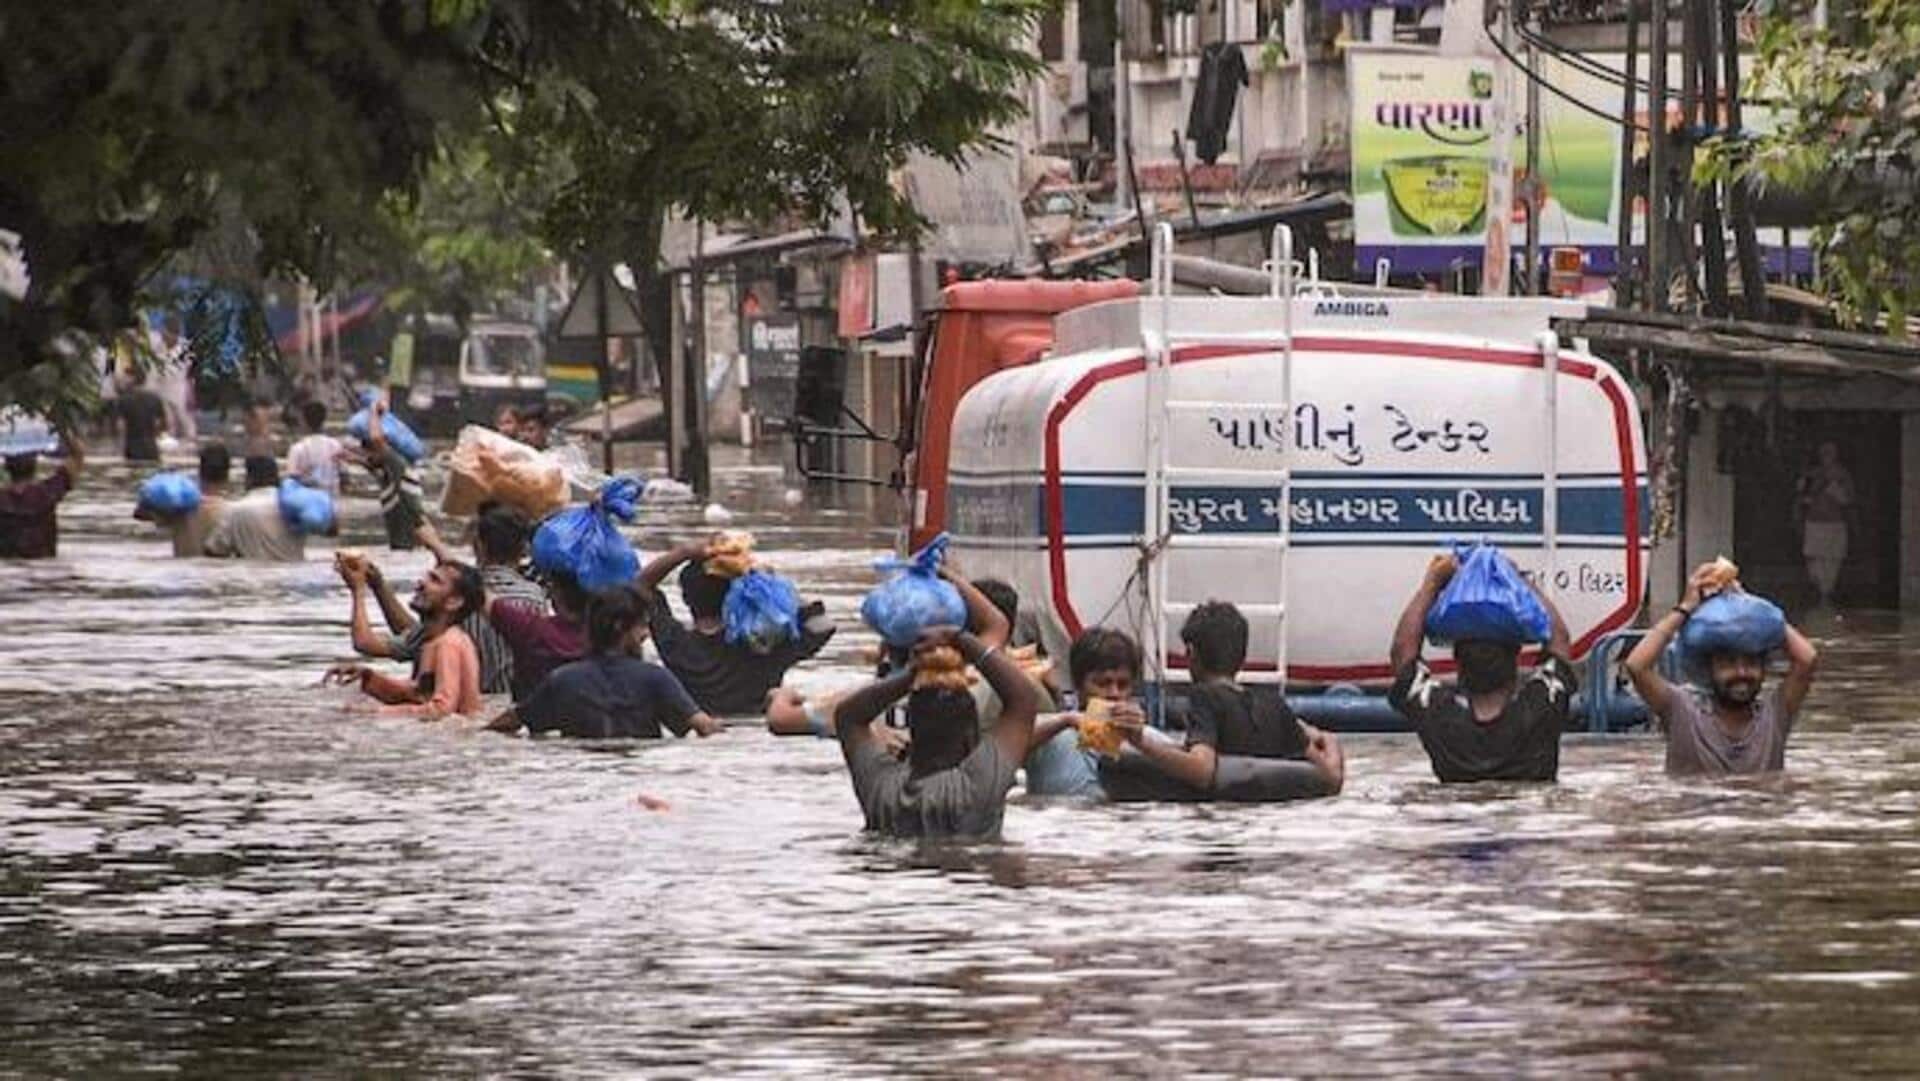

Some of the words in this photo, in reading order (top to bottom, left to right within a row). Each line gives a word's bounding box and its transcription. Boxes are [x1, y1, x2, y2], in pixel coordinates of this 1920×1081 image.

[1384, 405, 1490, 452] ટેન્કર
[1168, 497, 1249, 532] સુરત
[1415, 489, 1532, 523] પાલિકા
